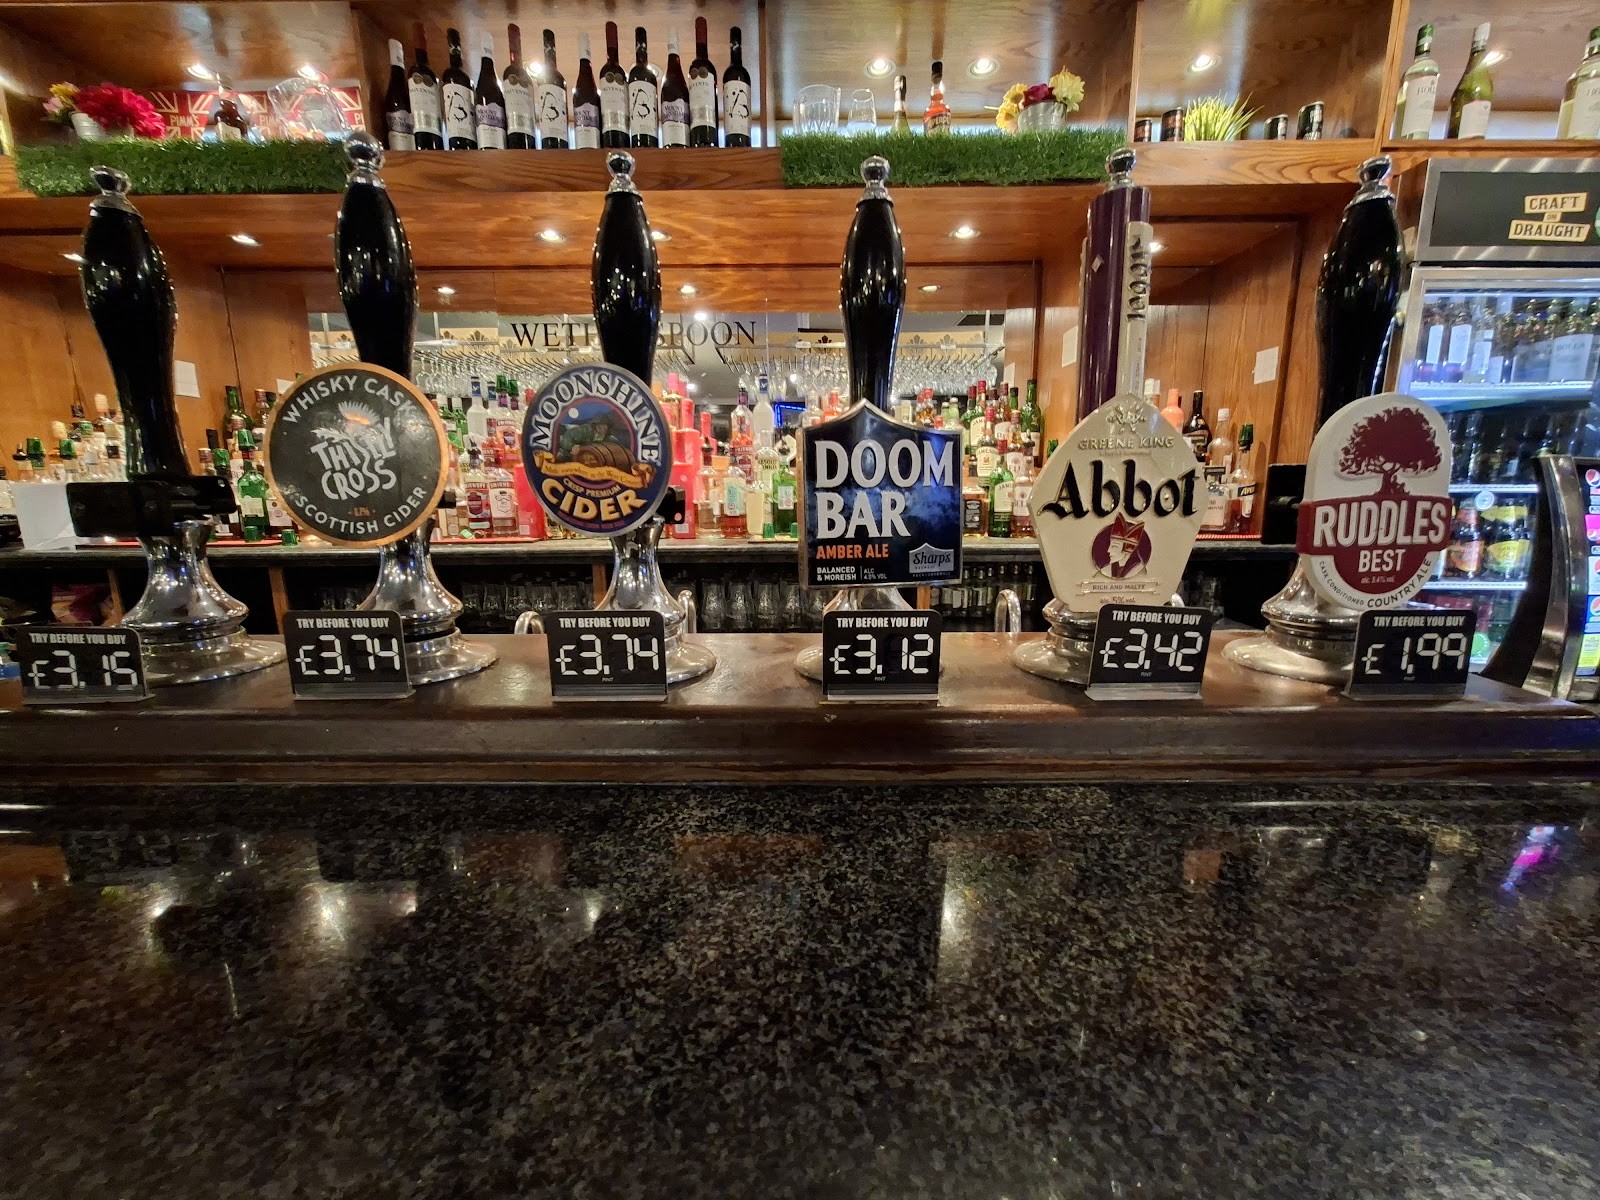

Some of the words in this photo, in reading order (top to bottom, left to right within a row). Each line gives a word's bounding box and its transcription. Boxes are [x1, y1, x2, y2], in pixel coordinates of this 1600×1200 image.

[1529, 196, 1580, 211] CRAFT
[1513, 223, 1585, 238] DRAUGHT
[282, 375, 358, 424] WHISKY
[363, 378, 417, 417] CASK
[531, 370, 662, 463] MOONSHINE
[814, 438, 955, 489] DOOM
[1078, 437, 1135, 450] GREENE
[1139, 436, 1175, 448] KING
[321, 459, 397, 501] CROSS
[541, 477, 648, 522] CIDER
[585, 484, 622, 498] PREMIUM
[1037, 458, 1201, 520] Abbot
[295, 493, 379, 535] SCOTTISH
[383, 485, 428, 528] CIDER
[814, 490, 912, 540] BAR
[1312, 499, 1447, 548] RUDDLES
[815, 544, 863, 560] AMBER
[865, 543, 889, 558] ALE
[816, 566, 856, 574] BALANCED
[912, 551, 951, 567] Sharp's
[1357, 548, 1407, 573] BEST
[816, 574, 823, 582] &
[824, 573, 857, 581] MOREISH
[1319, 560, 1329, 579] CASK
[1327, 578, 1365, 606] CONDITIONED
[1367, 580, 1418, 608] COUNTRY
[1416, 558, 1432, 583] ALE
[28, 632, 48, 643] TRY
[49, 633, 86, 644] BEFORE
[85, 634, 106, 645] YOU
[106, 634, 127, 645] BUY
[296, 618, 315, 628] TRY
[316, 618, 350, 628] BEFORE
[350, 617, 370, 628] YOU
[370, 617, 390, 628] BUY
[558, 617, 577, 628] TRY
[577, 617, 612, 628] BEFORE
[611, 617, 631, 628] YOU
[632, 616, 651, 627] BUY
[836, 617, 855, 628] TRY
[855, 617, 889, 628] BEFORE
[889, 616, 909, 628] YOU
[909, 616, 929, 628] BUY
[1112, 610, 1130, 621] TRY
[1129, 611, 1163, 623] BEFORE
[1163, 612, 1183, 625] YOU
[1182, 613, 1202, 626] BUY
[1373, 616, 1393, 627] TRY
[1391, 616, 1426, 627] BEFORE
[1426, 616, 1446, 627] YOU
[1445, 615, 1466, 626] BUY
[27, 649, 138, 691] £3.15
[295, 634, 400, 675] £3.74
[555, 633, 659, 675] £3.74
[828, 633, 934, 675] £3.12
[1099, 628, 1203, 672] £3.42
[1361, 632, 1467, 675] £1.99
